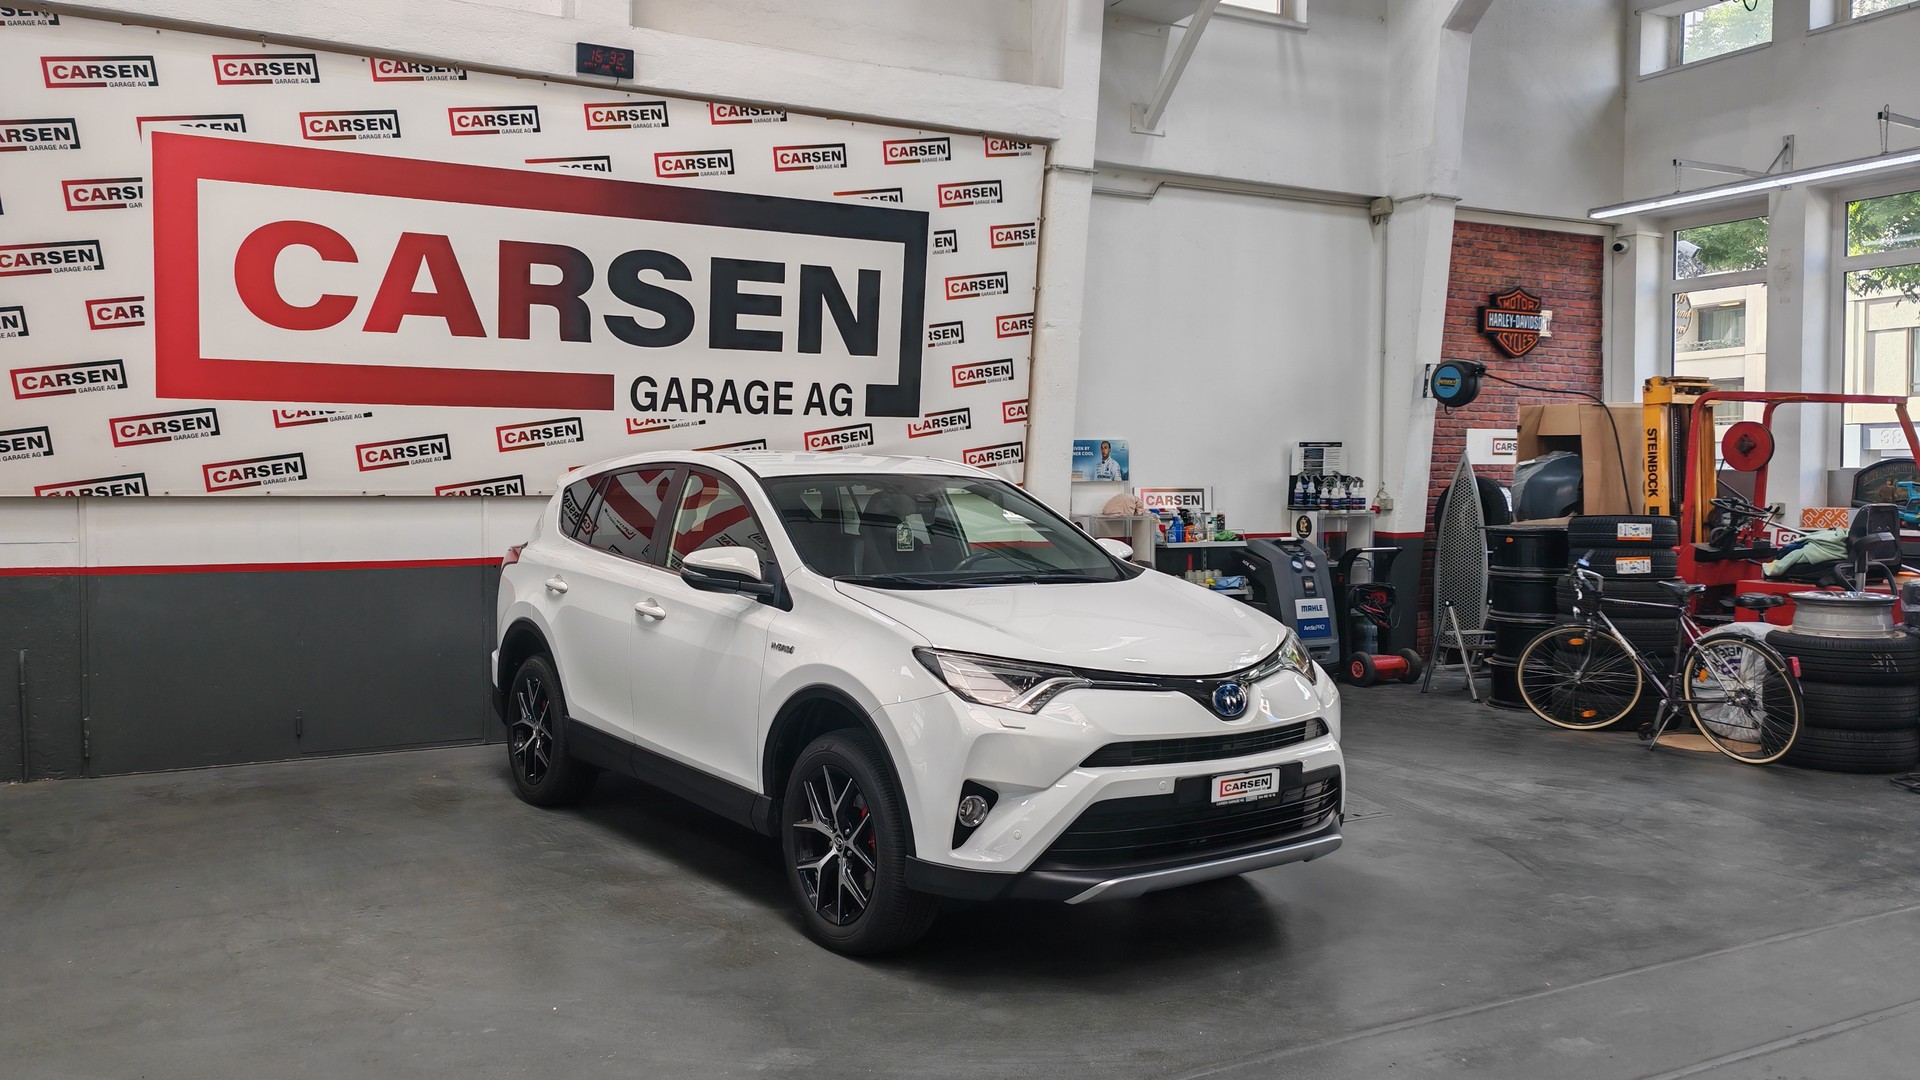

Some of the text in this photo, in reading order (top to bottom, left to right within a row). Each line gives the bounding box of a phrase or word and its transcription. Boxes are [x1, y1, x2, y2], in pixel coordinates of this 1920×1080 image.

[52, 65, 149, 79] CARSEN
[223, 62, 311, 76] CARSEN
[457, 113, 533, 128] CARSEN
[592, 108, 662, 122] CARSEN
[309, 118, 393, 133] CARSEN
[780, 151, 841, 164] CARSEN
[889, 144, 946, 158] CARSEN
[662, 157, 729, 171] CARSEN
[944, 187, 998, 200] CARSEN
[0, 249, 94, 268] CARSEN
[54, 266, 81, 274] GARAGE
[234, 220, 881, 356] CARSEN
[951, 278, 1004, 293] CARSEN
[1503, 295, 1535, 310] MOTOR
[1502, 333, 1534, 352] CYCLES
[22, 368, 118, 390] CARSEN
[958, 365, 1009, 381] CARSEN
[630, 375, 853, 417] GARAGE AG
[120, 416, 211, 438] CARSEN
[504, 424, 576, 444] CARSEN
[174, 433, 198, 441] GARAGE
[810, 429, 868, 448] CARSEN
[2, 453, 30, 461] GARAGE
[365, 442, 443, 463] CARSEN
[968, 448, 1019, 464] CARSEN
[1647, 428, 1658, 498] STEINBOCK
[213, 461, 299, 483] CARSEN
[263, 477, 287, 485] GARAGE
[1145, 495, 1201, 506] CARSEN
[1301, 604, 1323, 612] MAHLE
[1224, 777, 1269, 792] CARSEN
